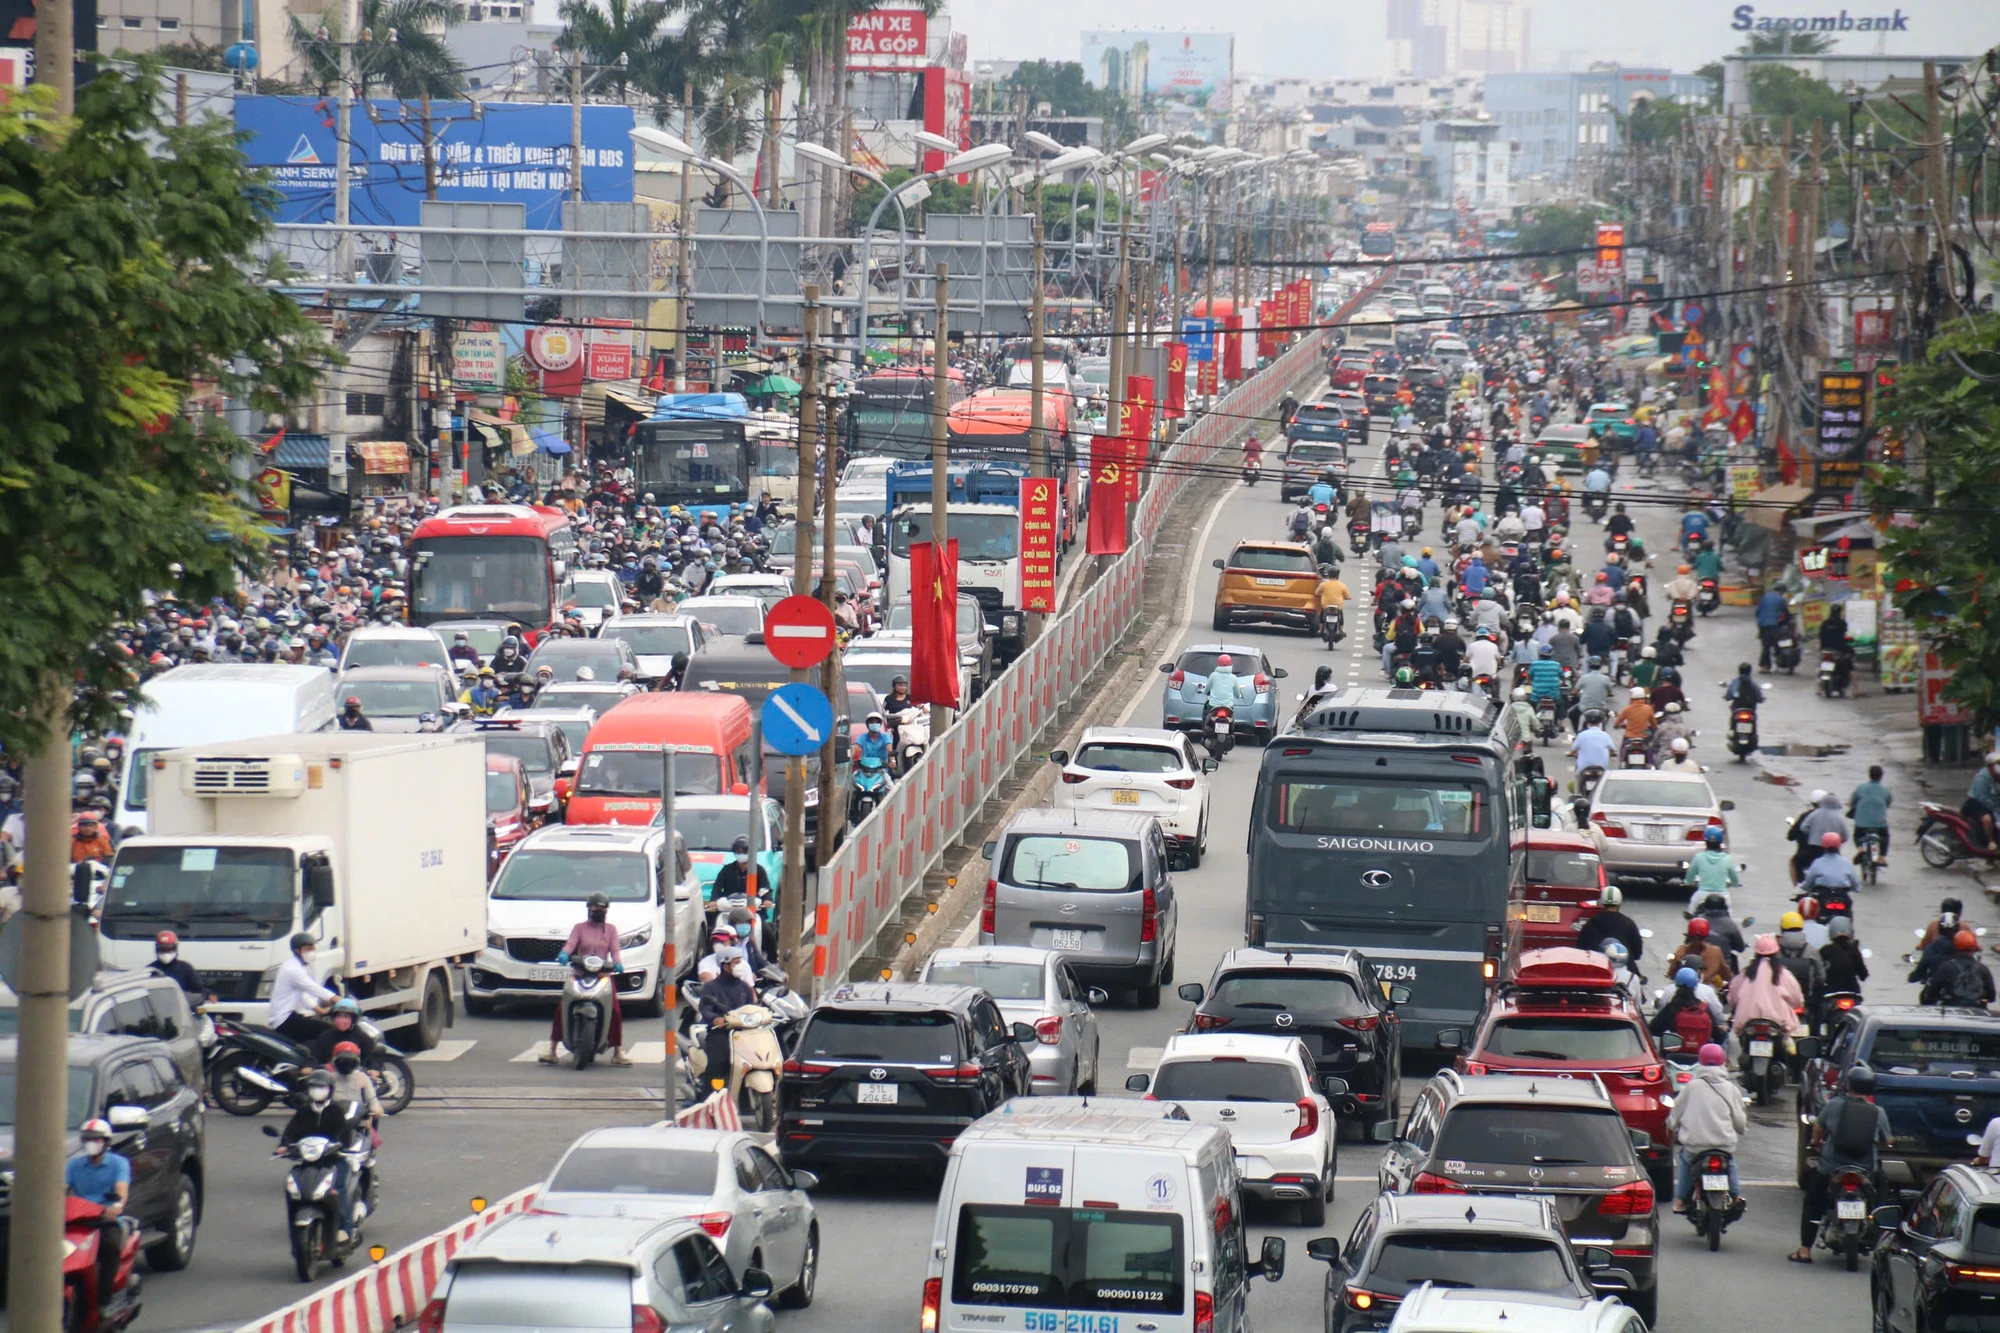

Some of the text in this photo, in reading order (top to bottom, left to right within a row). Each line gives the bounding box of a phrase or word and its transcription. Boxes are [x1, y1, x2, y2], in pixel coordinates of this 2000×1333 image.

[888, 16, 912, 32] XE
[1731, 5, 1910, 31] Sacombank
[847, 33, 918, 52] RẢ GÓP
[474, 146, 483, 163] &
[525, 147, 553, 165] KHAI
[546, 335, 567, 355] 15
[694, 445, 706, 456] 19
[1068, 842, 1078, 850] 36
[1317, 837, 1434, 852] SAIGONLIMO
[1371, 965, 1417, 980] 78.94
[870, 1085, 886, 1093] 51L
[862, 1093, 893, 1103] 204.64
[1027, 1184, 1061, 1194] BUS 02
[973, 1282, 1039, 1294] 0903176789
[1097, 1289, 1164, 1300] 0909019122
[1025, 1312, 1118, 1333] 51B-211.61
